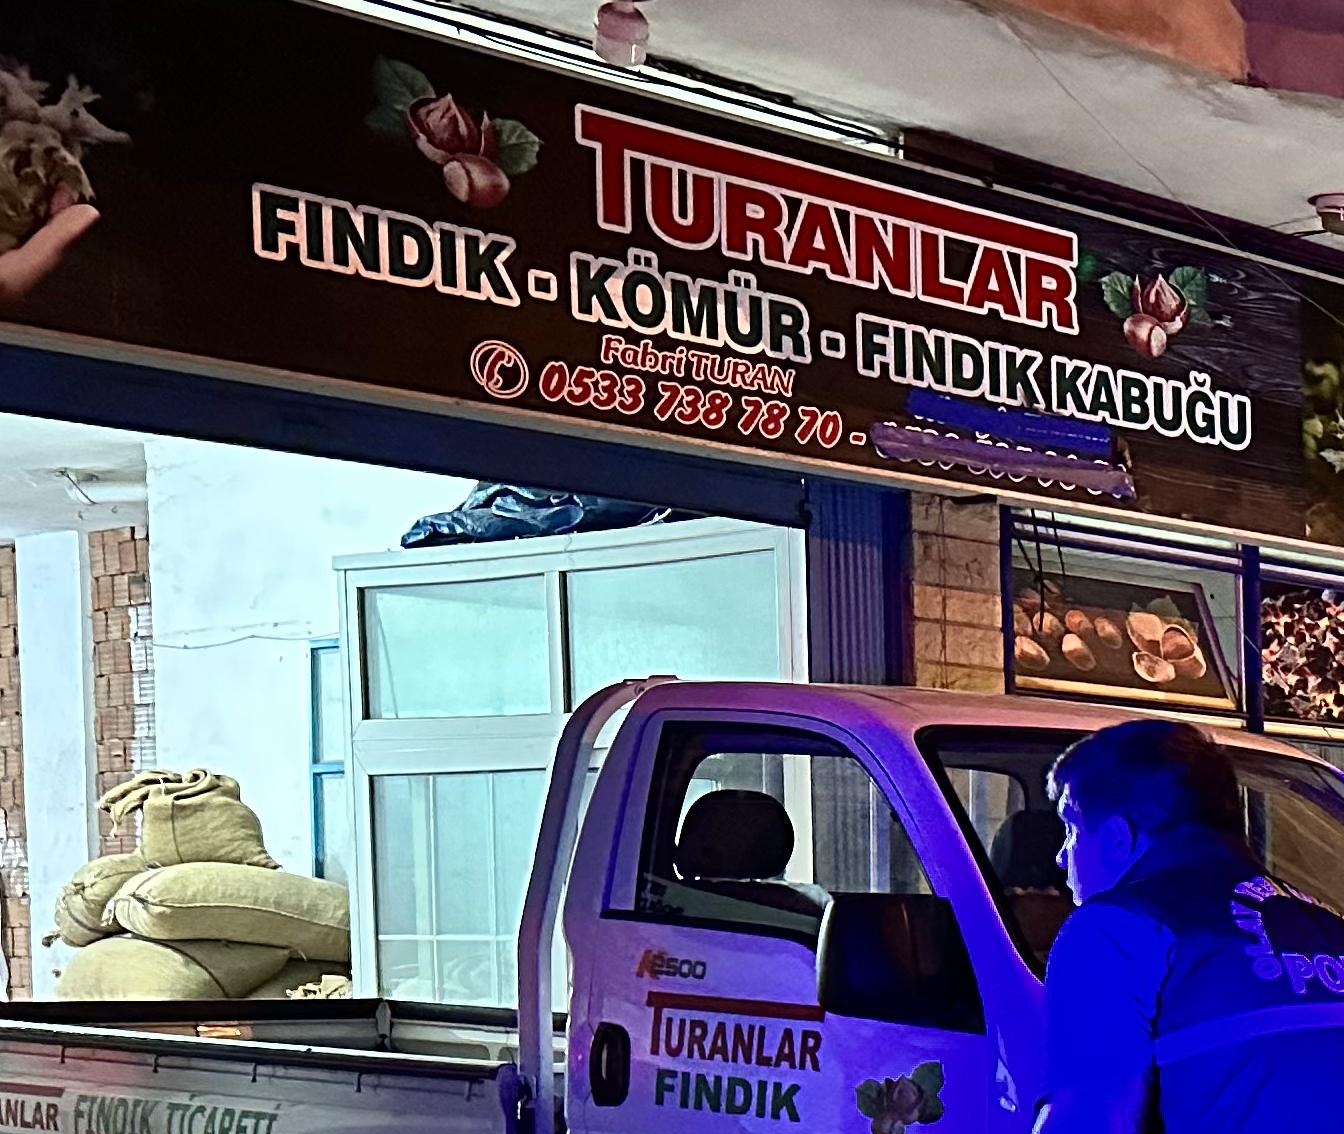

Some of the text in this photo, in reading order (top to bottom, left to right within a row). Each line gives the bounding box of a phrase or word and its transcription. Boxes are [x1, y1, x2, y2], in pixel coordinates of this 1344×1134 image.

[574, 105, 1079, 334] TURANLAR
[252, 184, 520, 305] FINDIK
[570, 248, 813, 364] KÖMÜR
[856, 314, 1046, 409] FINDIK
[1051, 355, 1251, 451] KABUĞU
[539, 361, 646, 415] 0533
[654, 381, 732, 429] 738
[738, 396, 790, 438] 78
[794, 406, 843, 448] 70
[688, 351, 796, 397] TURAN
[647, 991, 825, 1072] TURANLAR
[654, 1068, 801, 1123] FINDIK
